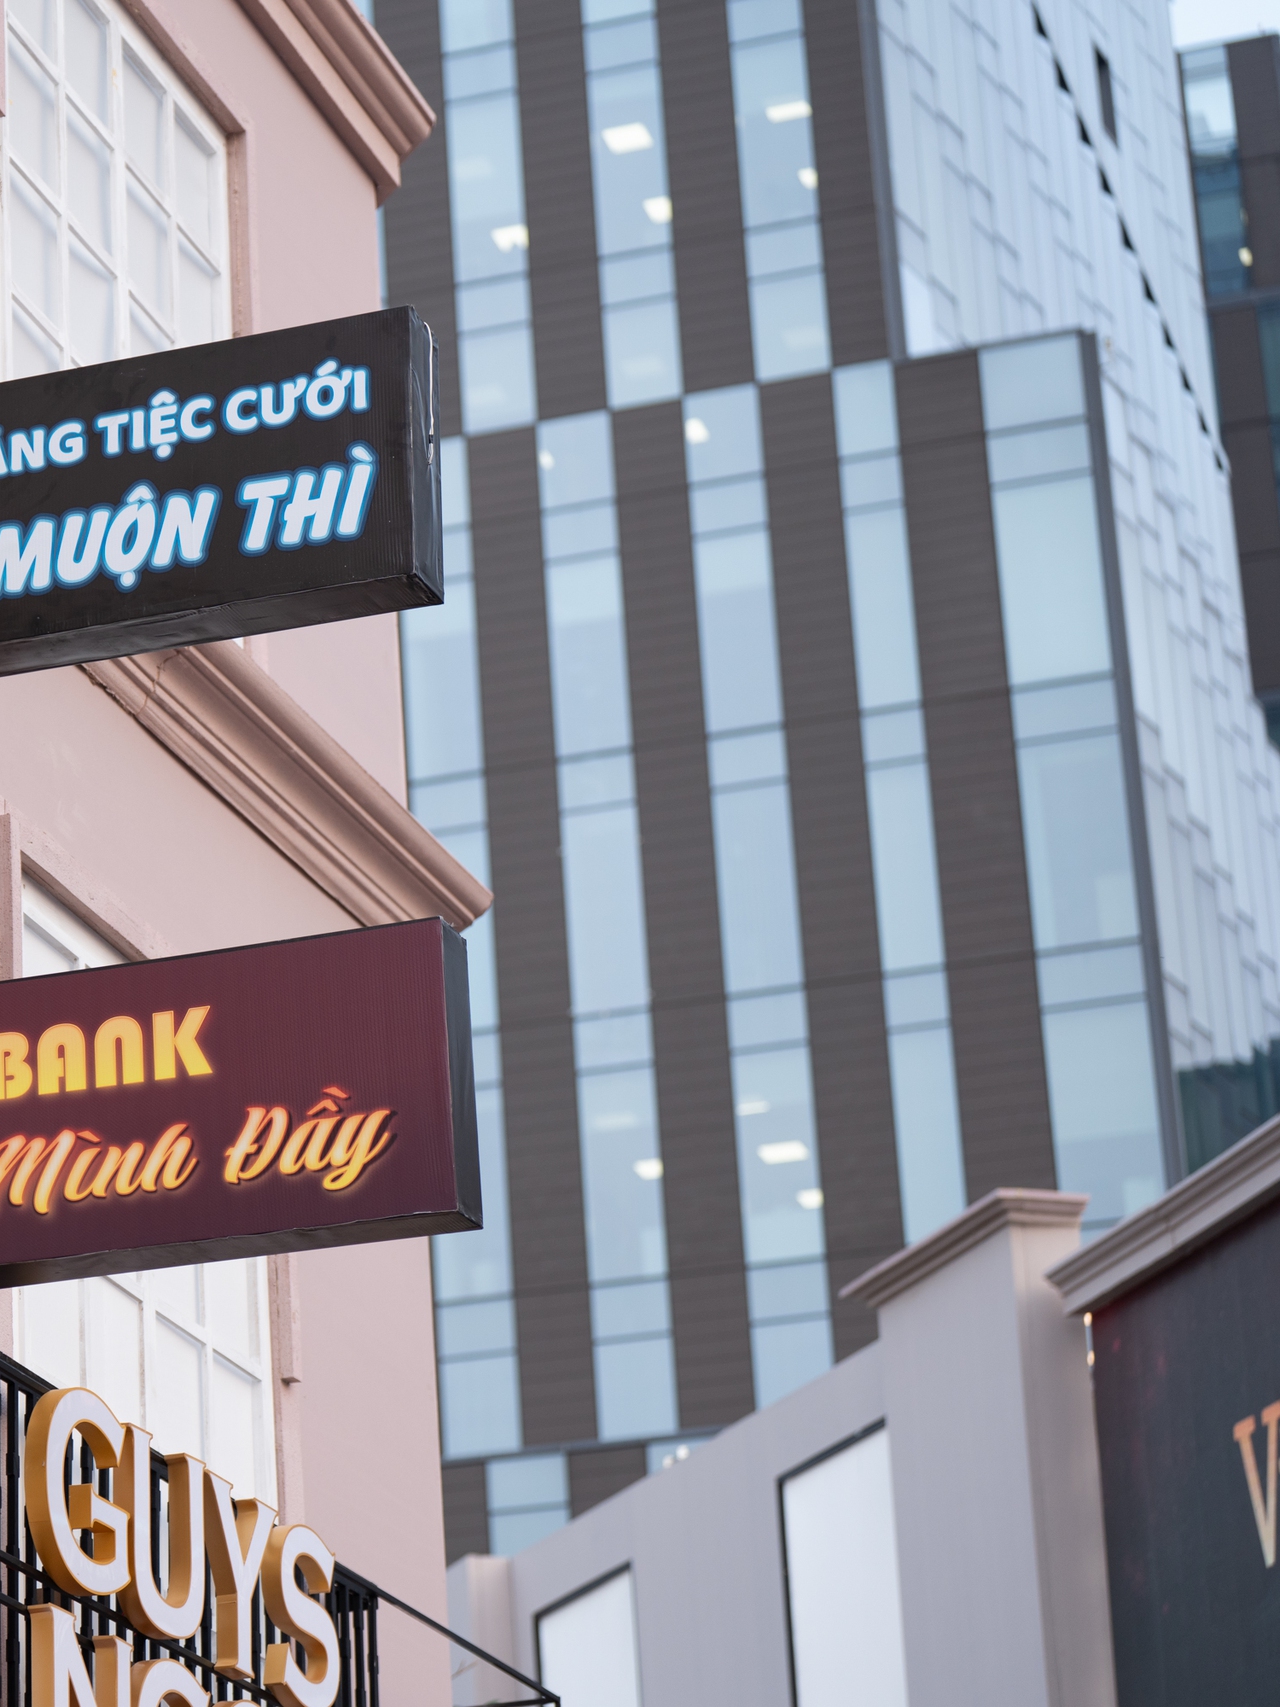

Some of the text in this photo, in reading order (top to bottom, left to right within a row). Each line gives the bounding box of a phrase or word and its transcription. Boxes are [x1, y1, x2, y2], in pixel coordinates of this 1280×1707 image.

[96, 389, 214, 460] TIỆC
[223, 359, 371, 432] CƯỚI
[238, 444, 377, 553] THÌ
[225, 1086, 392, 1191] Đầy
[25, 1387, 341, 1707] GUYS
